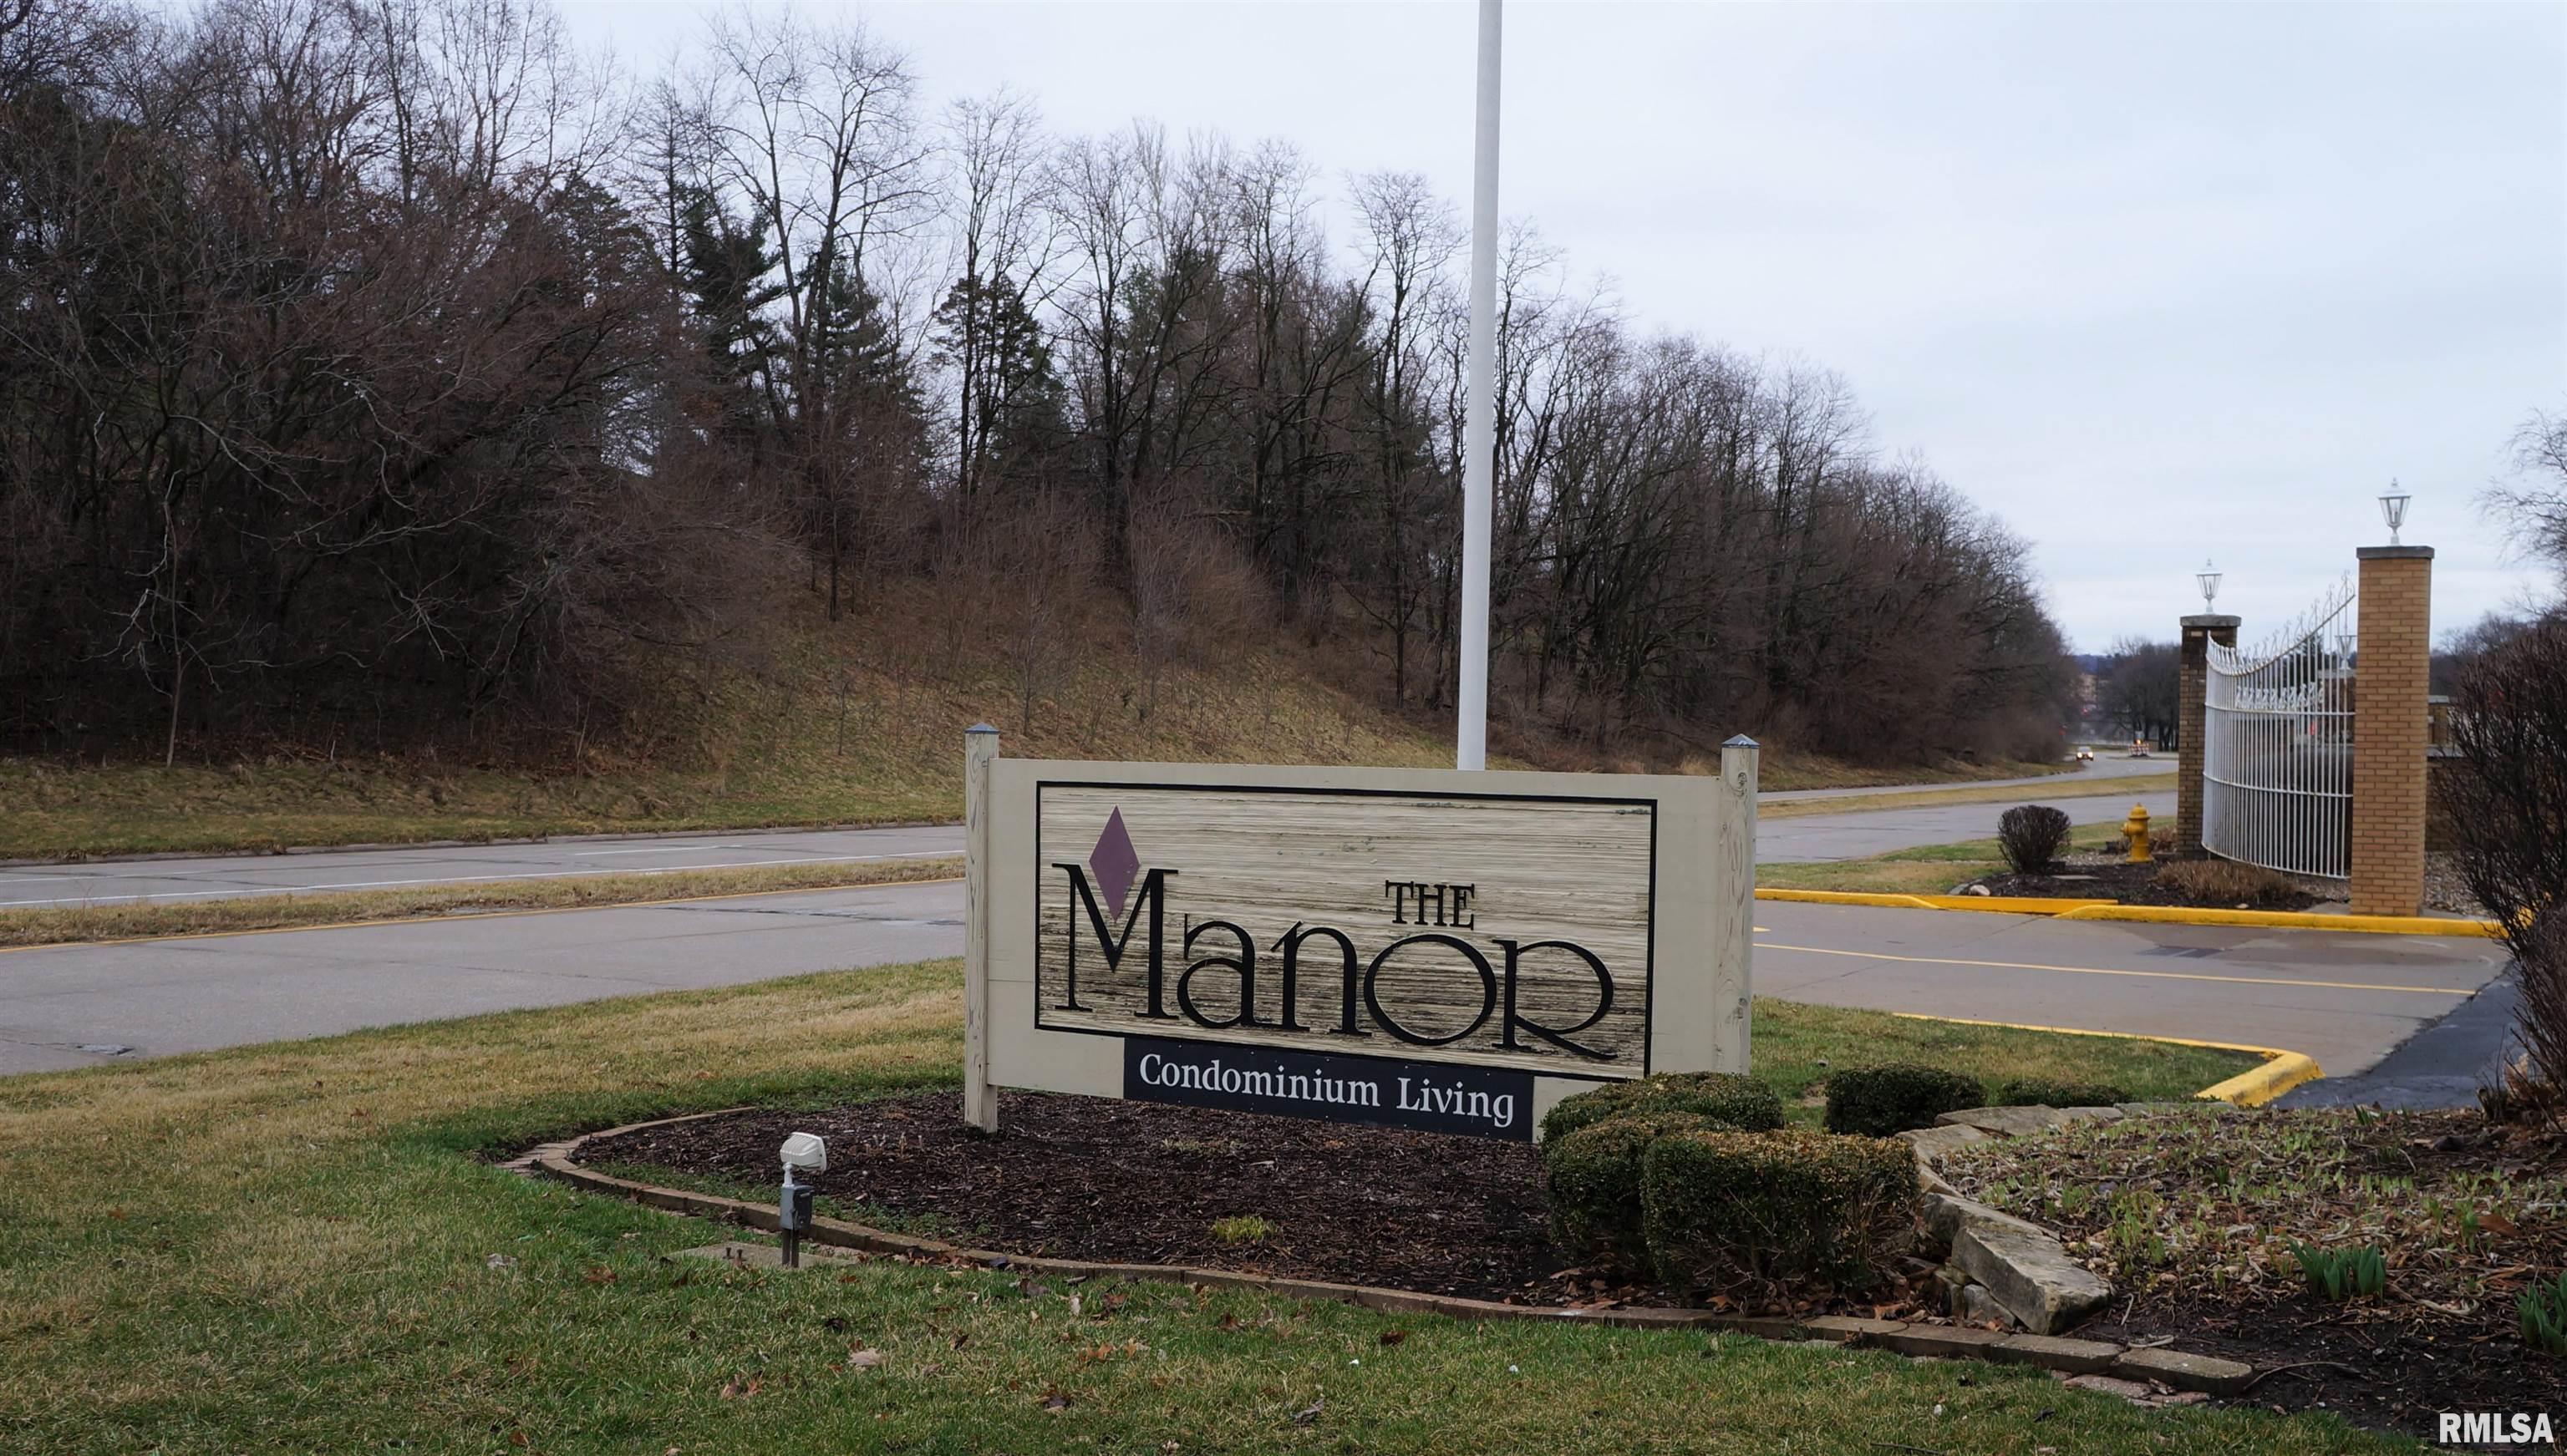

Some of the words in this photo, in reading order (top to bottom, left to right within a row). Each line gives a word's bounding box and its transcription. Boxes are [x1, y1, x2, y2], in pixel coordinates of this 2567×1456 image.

[1385, 879, 1476, 930] THE
[1139, 1053, 1380, 1108] Condominium
[1396, 1076, 1515, 1129] Living
